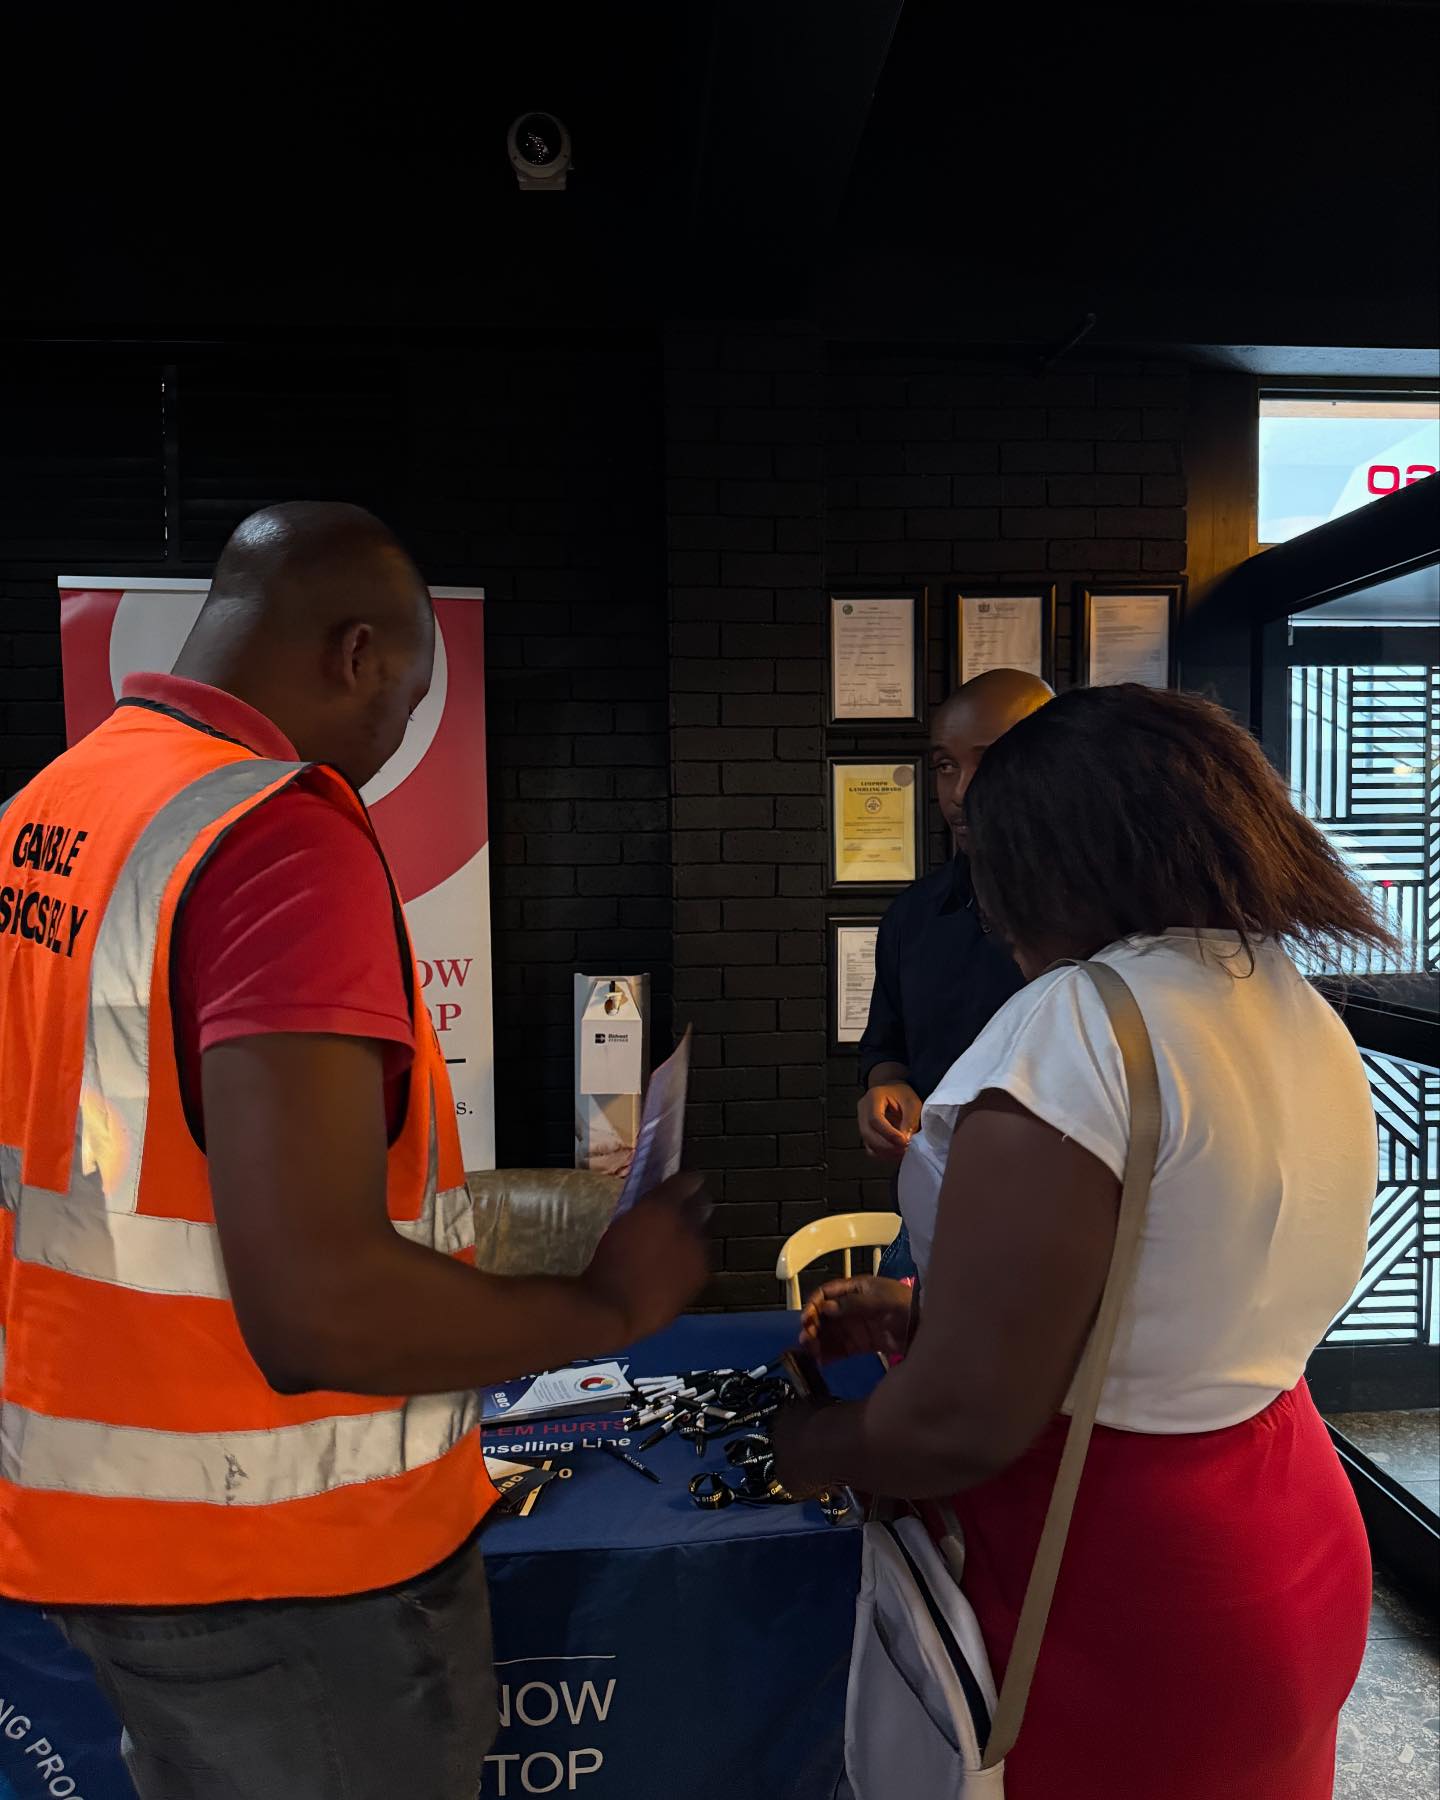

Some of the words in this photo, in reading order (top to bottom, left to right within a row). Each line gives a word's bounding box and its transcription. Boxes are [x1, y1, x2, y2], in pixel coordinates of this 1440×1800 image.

[543, 1419, 625, 1434] HURTS
[582, 1437, 631, 1449] Line
[24, 1736, 85, 1800] PRO
